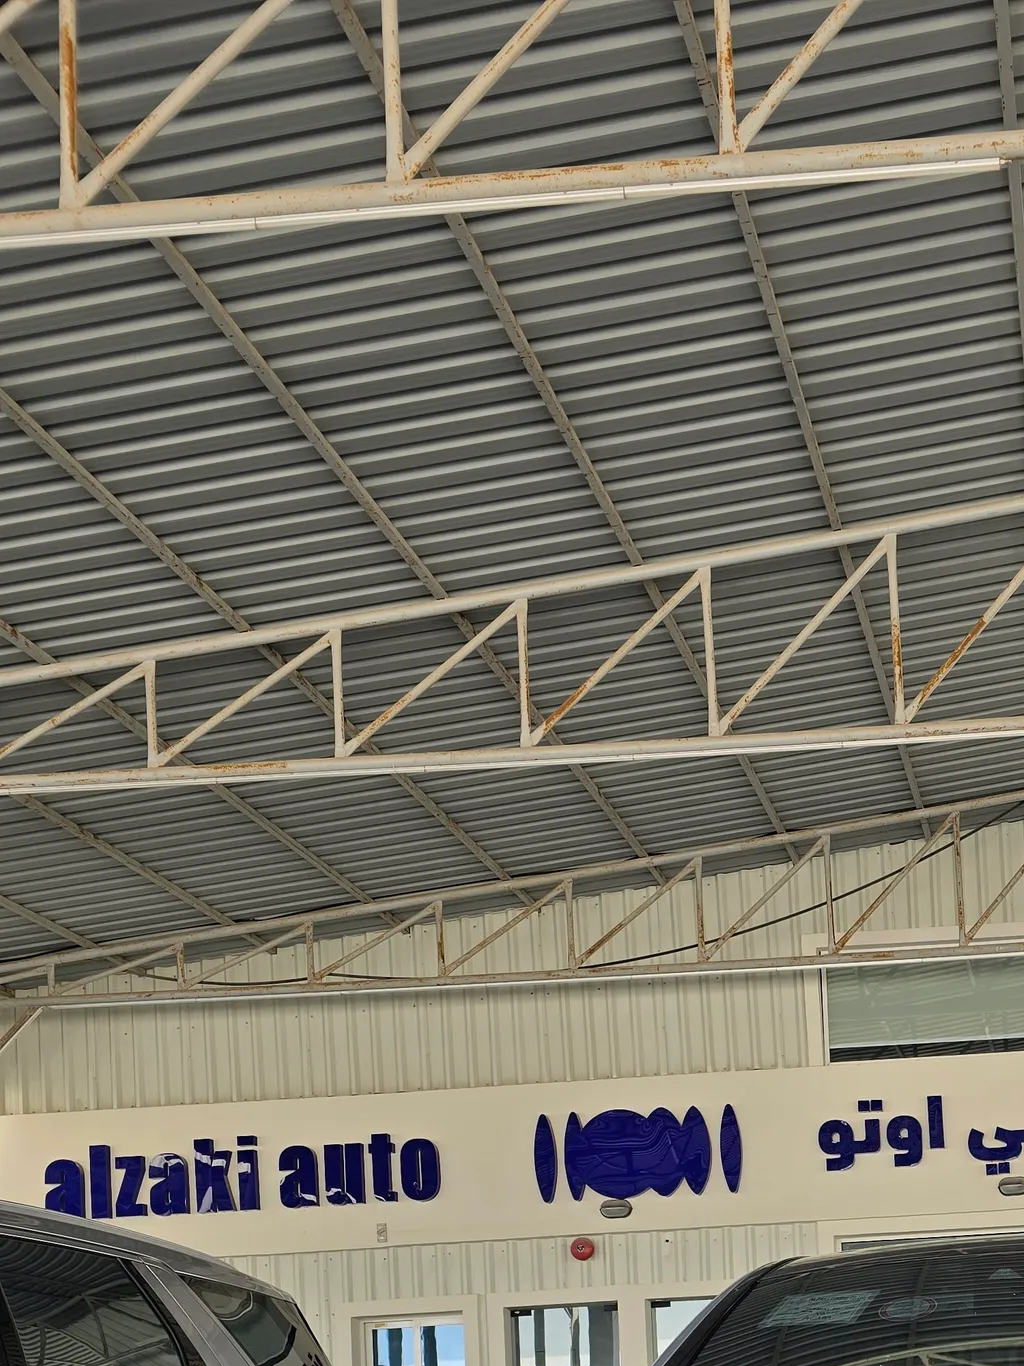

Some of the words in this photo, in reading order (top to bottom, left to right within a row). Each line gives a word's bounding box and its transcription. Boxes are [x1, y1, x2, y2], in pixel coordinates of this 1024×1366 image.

[818, 1095, 946, 1172] اوتو
[44, 1135, 261, 1219] alzaki
[278, 1132, 441, 1209] auto
